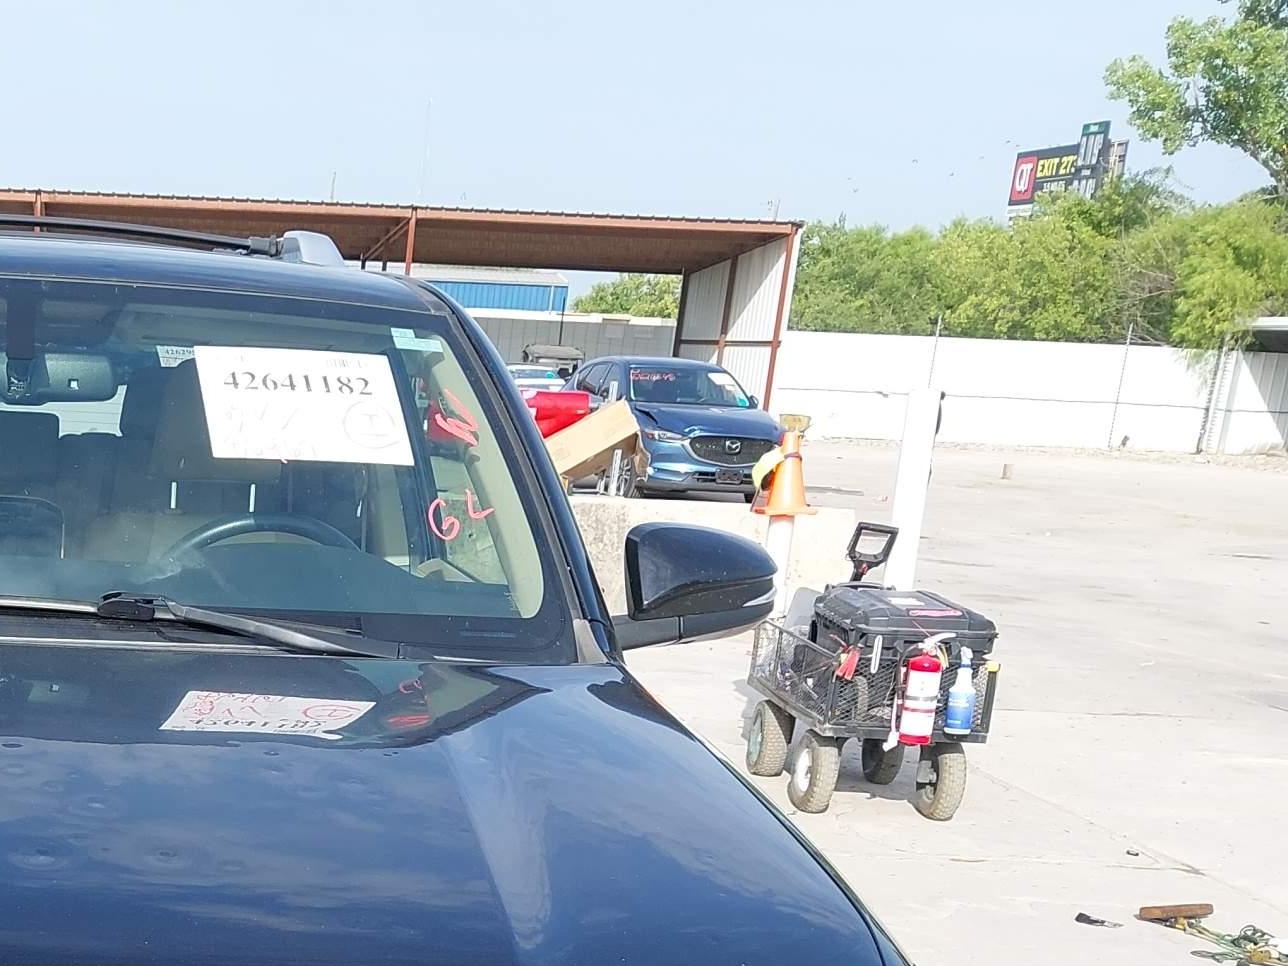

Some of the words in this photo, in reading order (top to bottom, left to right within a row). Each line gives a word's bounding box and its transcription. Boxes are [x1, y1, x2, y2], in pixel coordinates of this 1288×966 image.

[1015, 163, 1033, 193] QT
[1036, 157, 1060, 178] EXIT
[222, 370, 374, 397] 42641182
